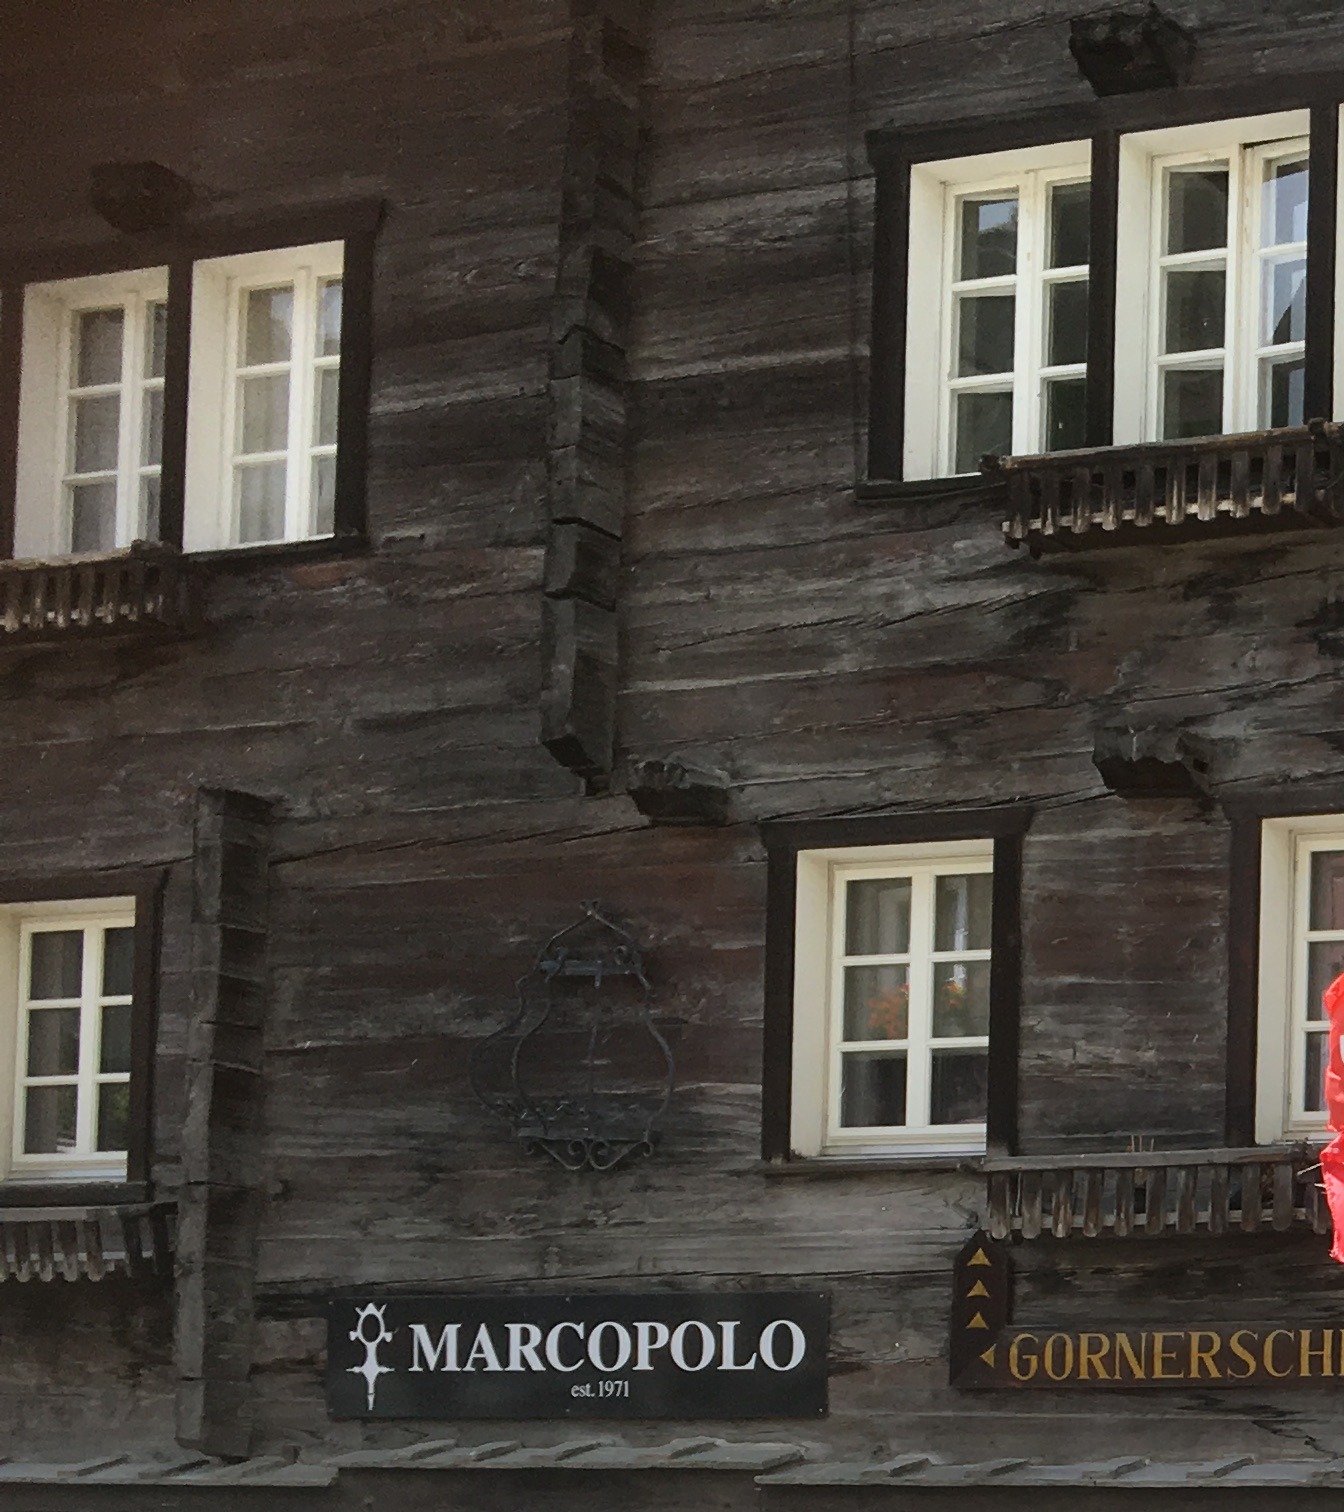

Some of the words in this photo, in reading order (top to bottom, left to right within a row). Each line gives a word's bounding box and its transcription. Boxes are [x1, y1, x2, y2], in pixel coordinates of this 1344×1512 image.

[408, 1319, 807, 1374] MARCOPOLO
[570, 1380, 595, 1398] est.
[597, 1380, 630, 1398] 1971
